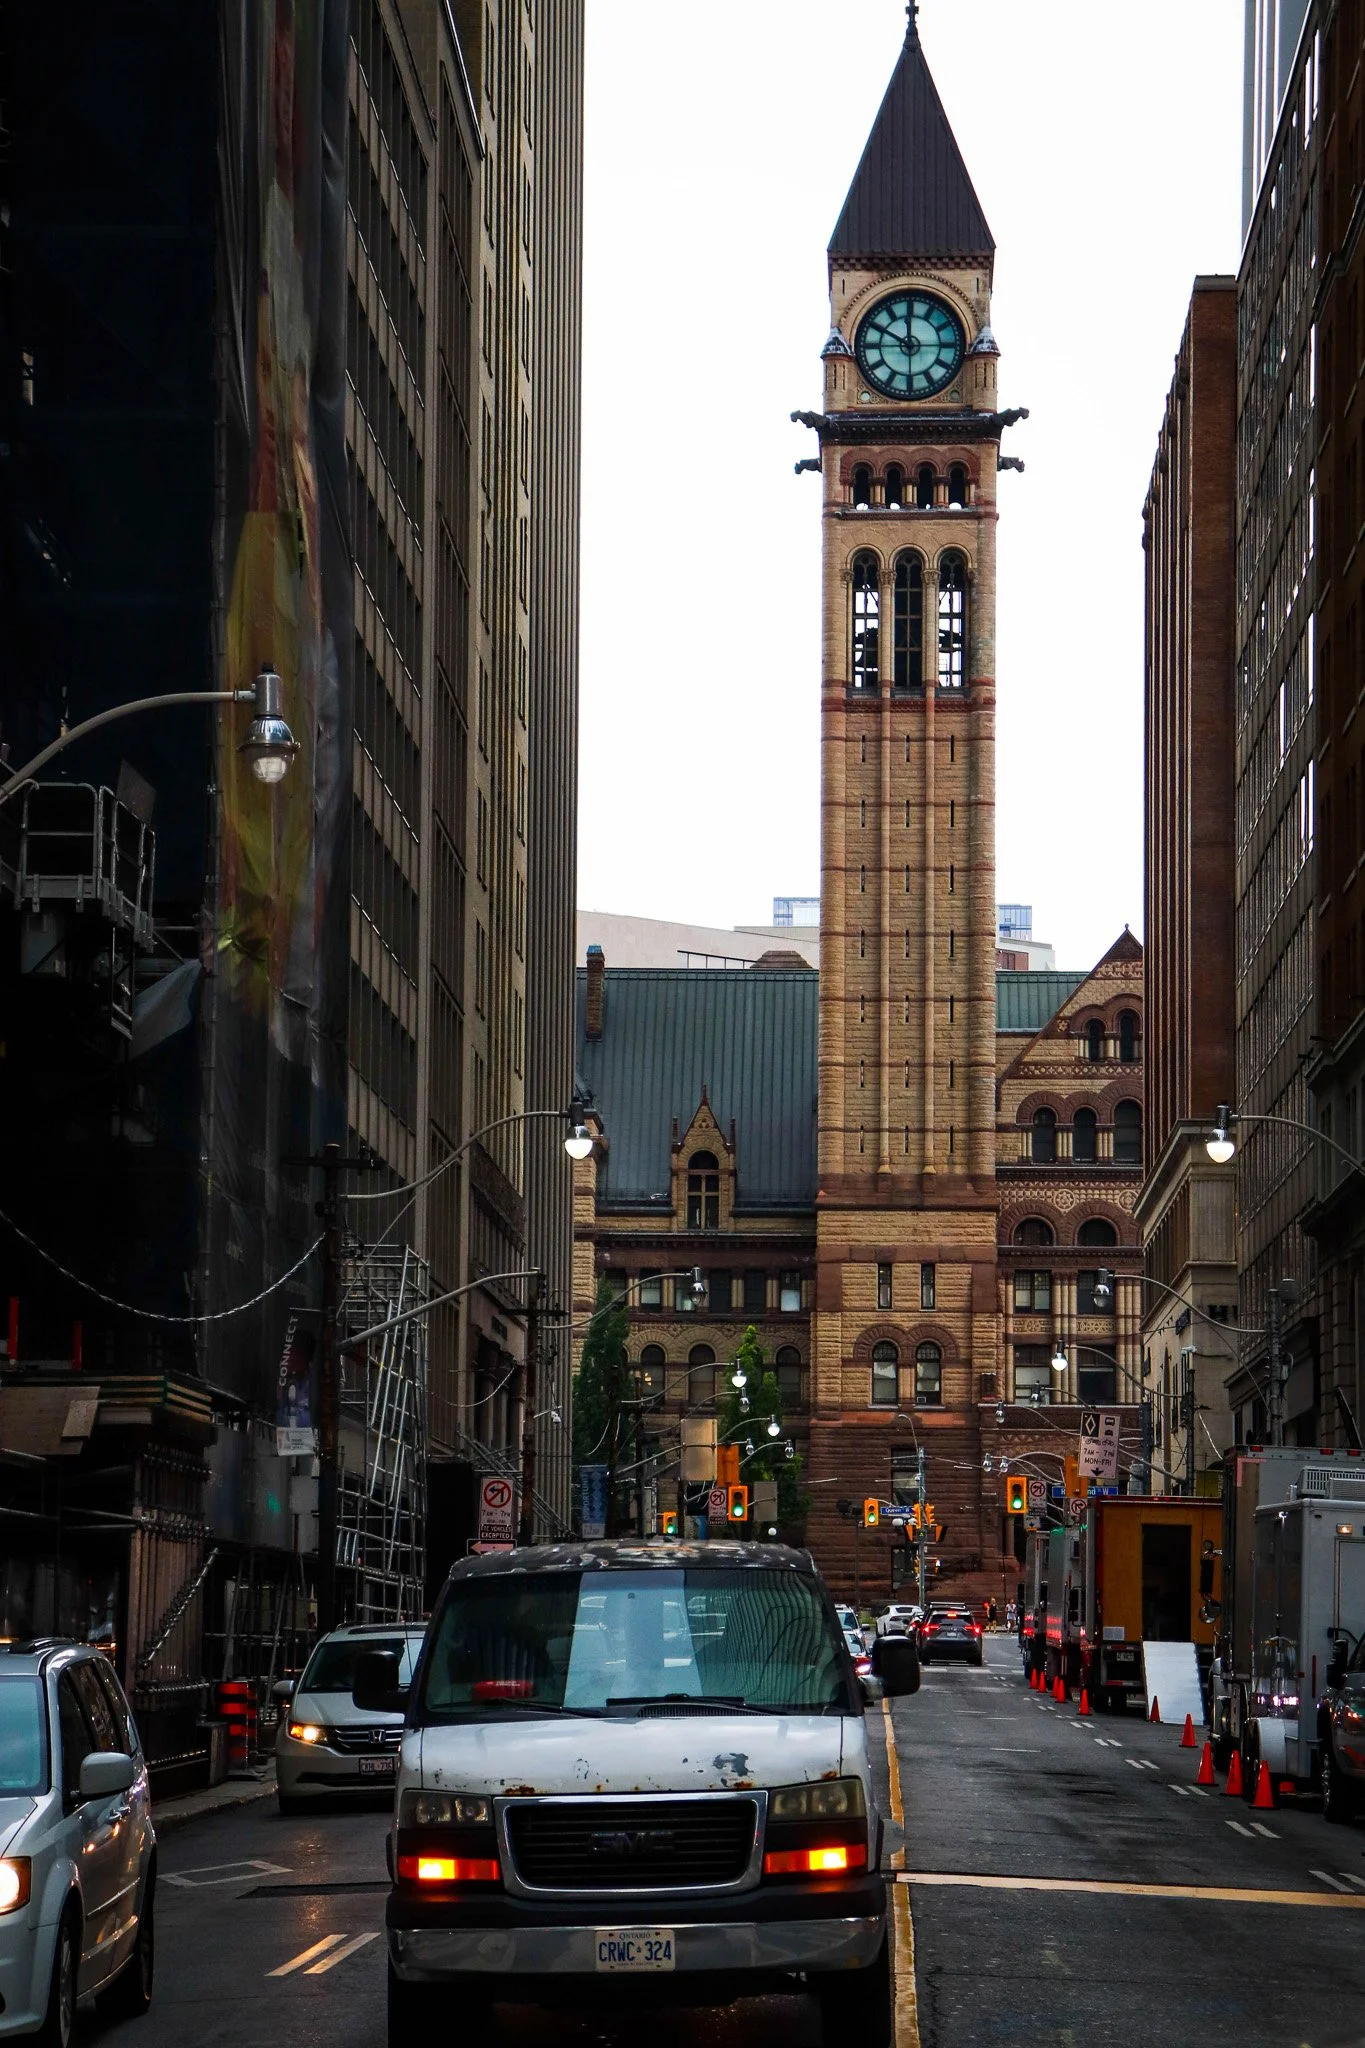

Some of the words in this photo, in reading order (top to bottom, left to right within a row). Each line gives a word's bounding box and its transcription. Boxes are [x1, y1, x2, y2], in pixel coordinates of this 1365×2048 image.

[278, 1315, 299, 1387] CONNECT
[1083, 1447, 1095, 1455] 7AM
[1084, 1457, 1112, 1466] MON-FRI
[619, 1932, 651, 1940] ONTARIO
[598, 1941, 635, 1962] CRWC
[644, 1940, 672, 1961] 324
